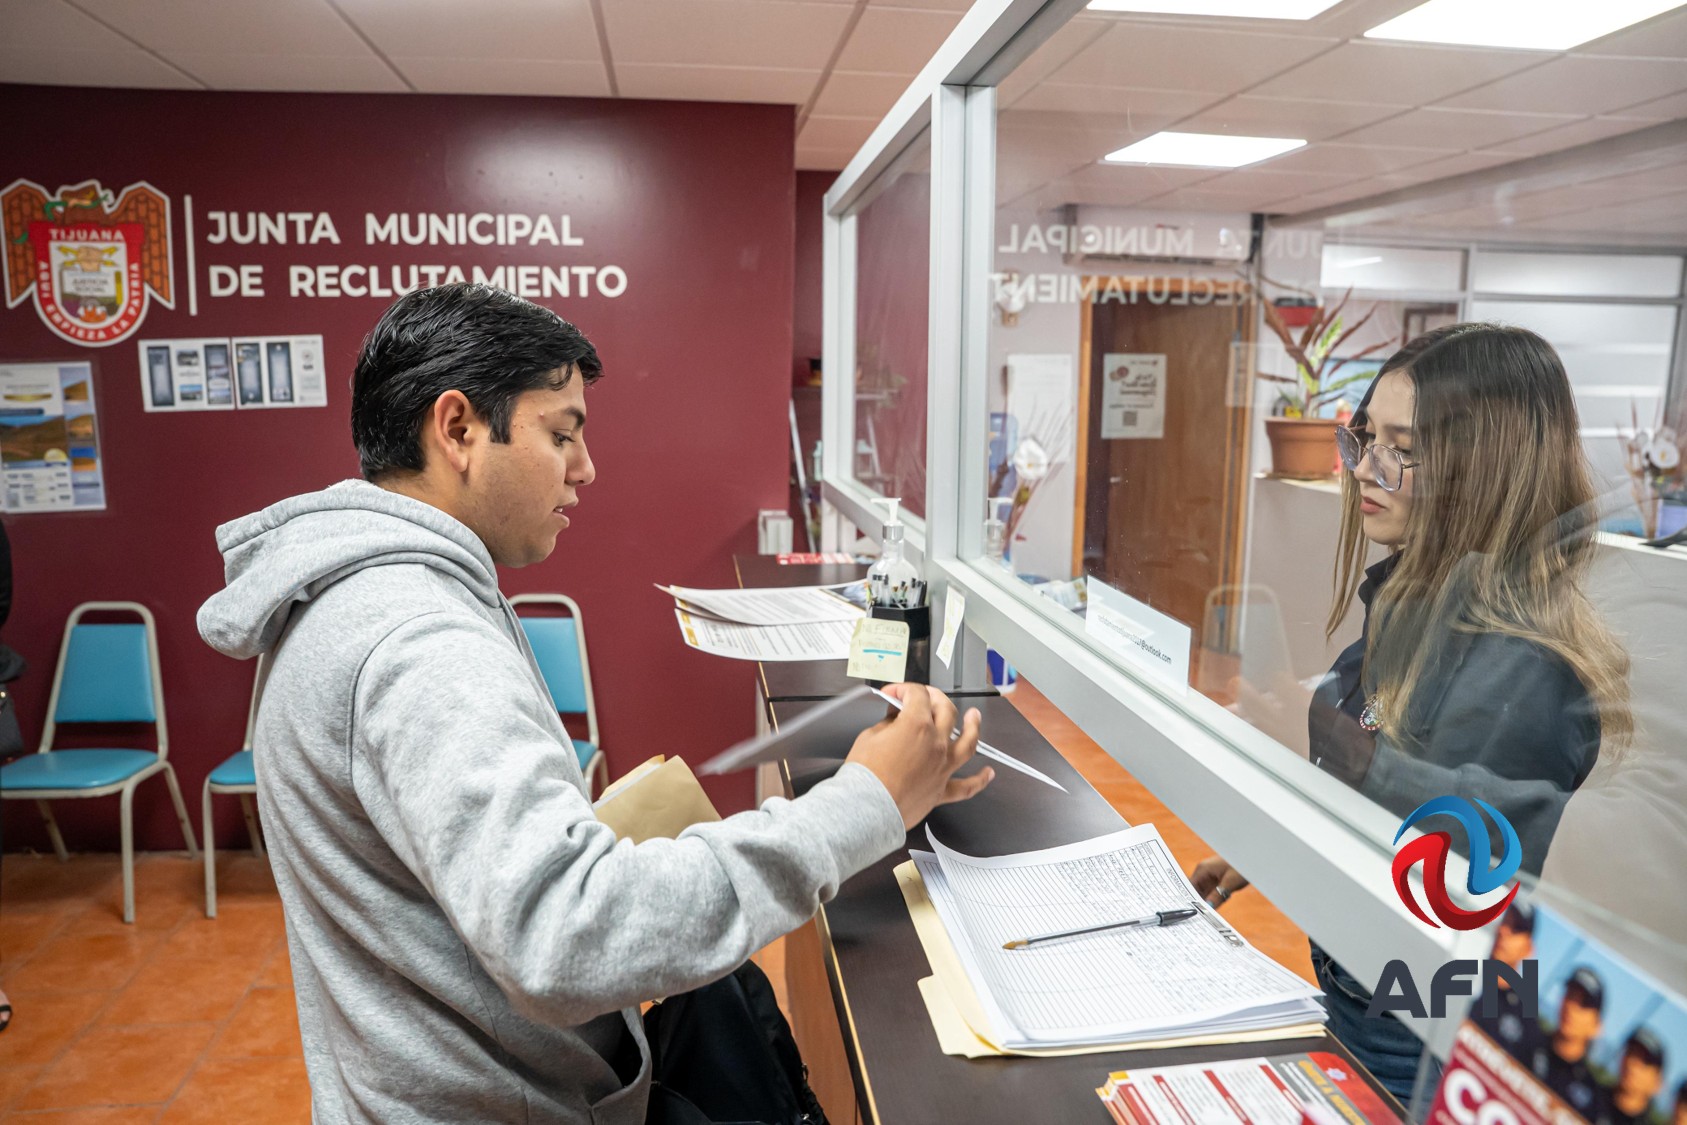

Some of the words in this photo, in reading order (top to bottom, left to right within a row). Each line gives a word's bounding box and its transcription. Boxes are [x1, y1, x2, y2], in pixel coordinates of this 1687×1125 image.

[48, 228, 125, 241] TIJUANA
[207, 211, 341, 245] JUNTA
[365, 212, 584, 247] MUNICIPAL
[111, 318, 130, 335] LA
[127, 262, 141, 317] PATRIA
[209, 264, 265, 298] DE
[289, 264, 629, 299] RECLUTAMIENTO
